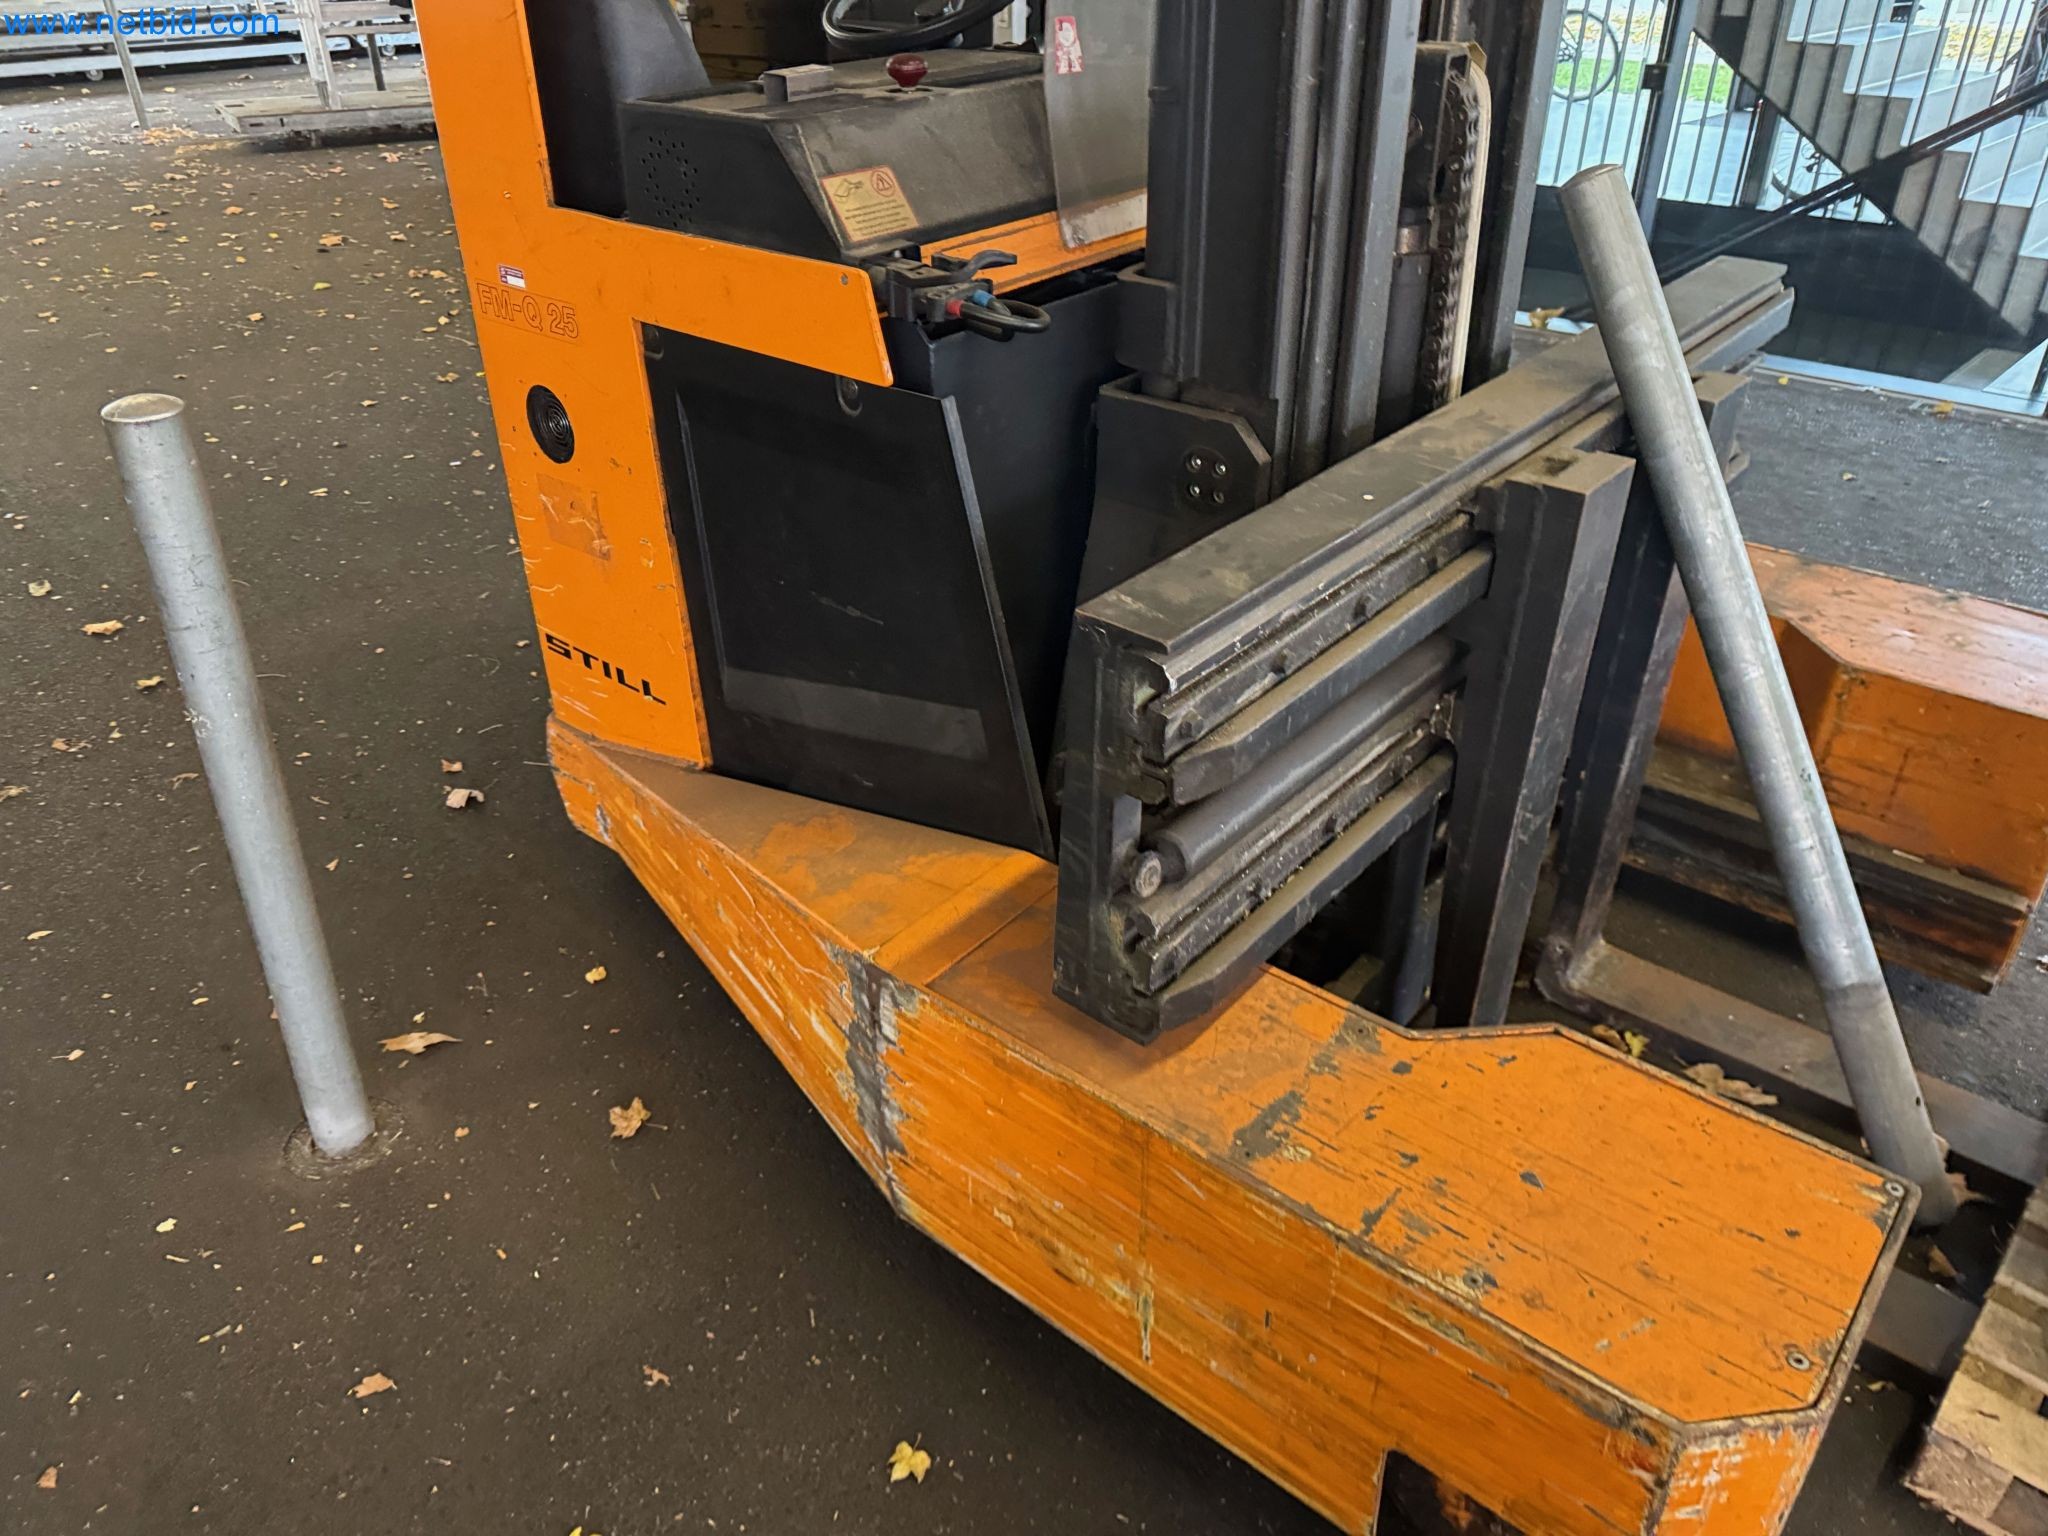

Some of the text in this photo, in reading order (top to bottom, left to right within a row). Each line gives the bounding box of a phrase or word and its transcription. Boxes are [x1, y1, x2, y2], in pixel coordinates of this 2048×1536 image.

[476, 282, 579, 339] FM-Q 25
[545, 633, 667, 706] STILL
